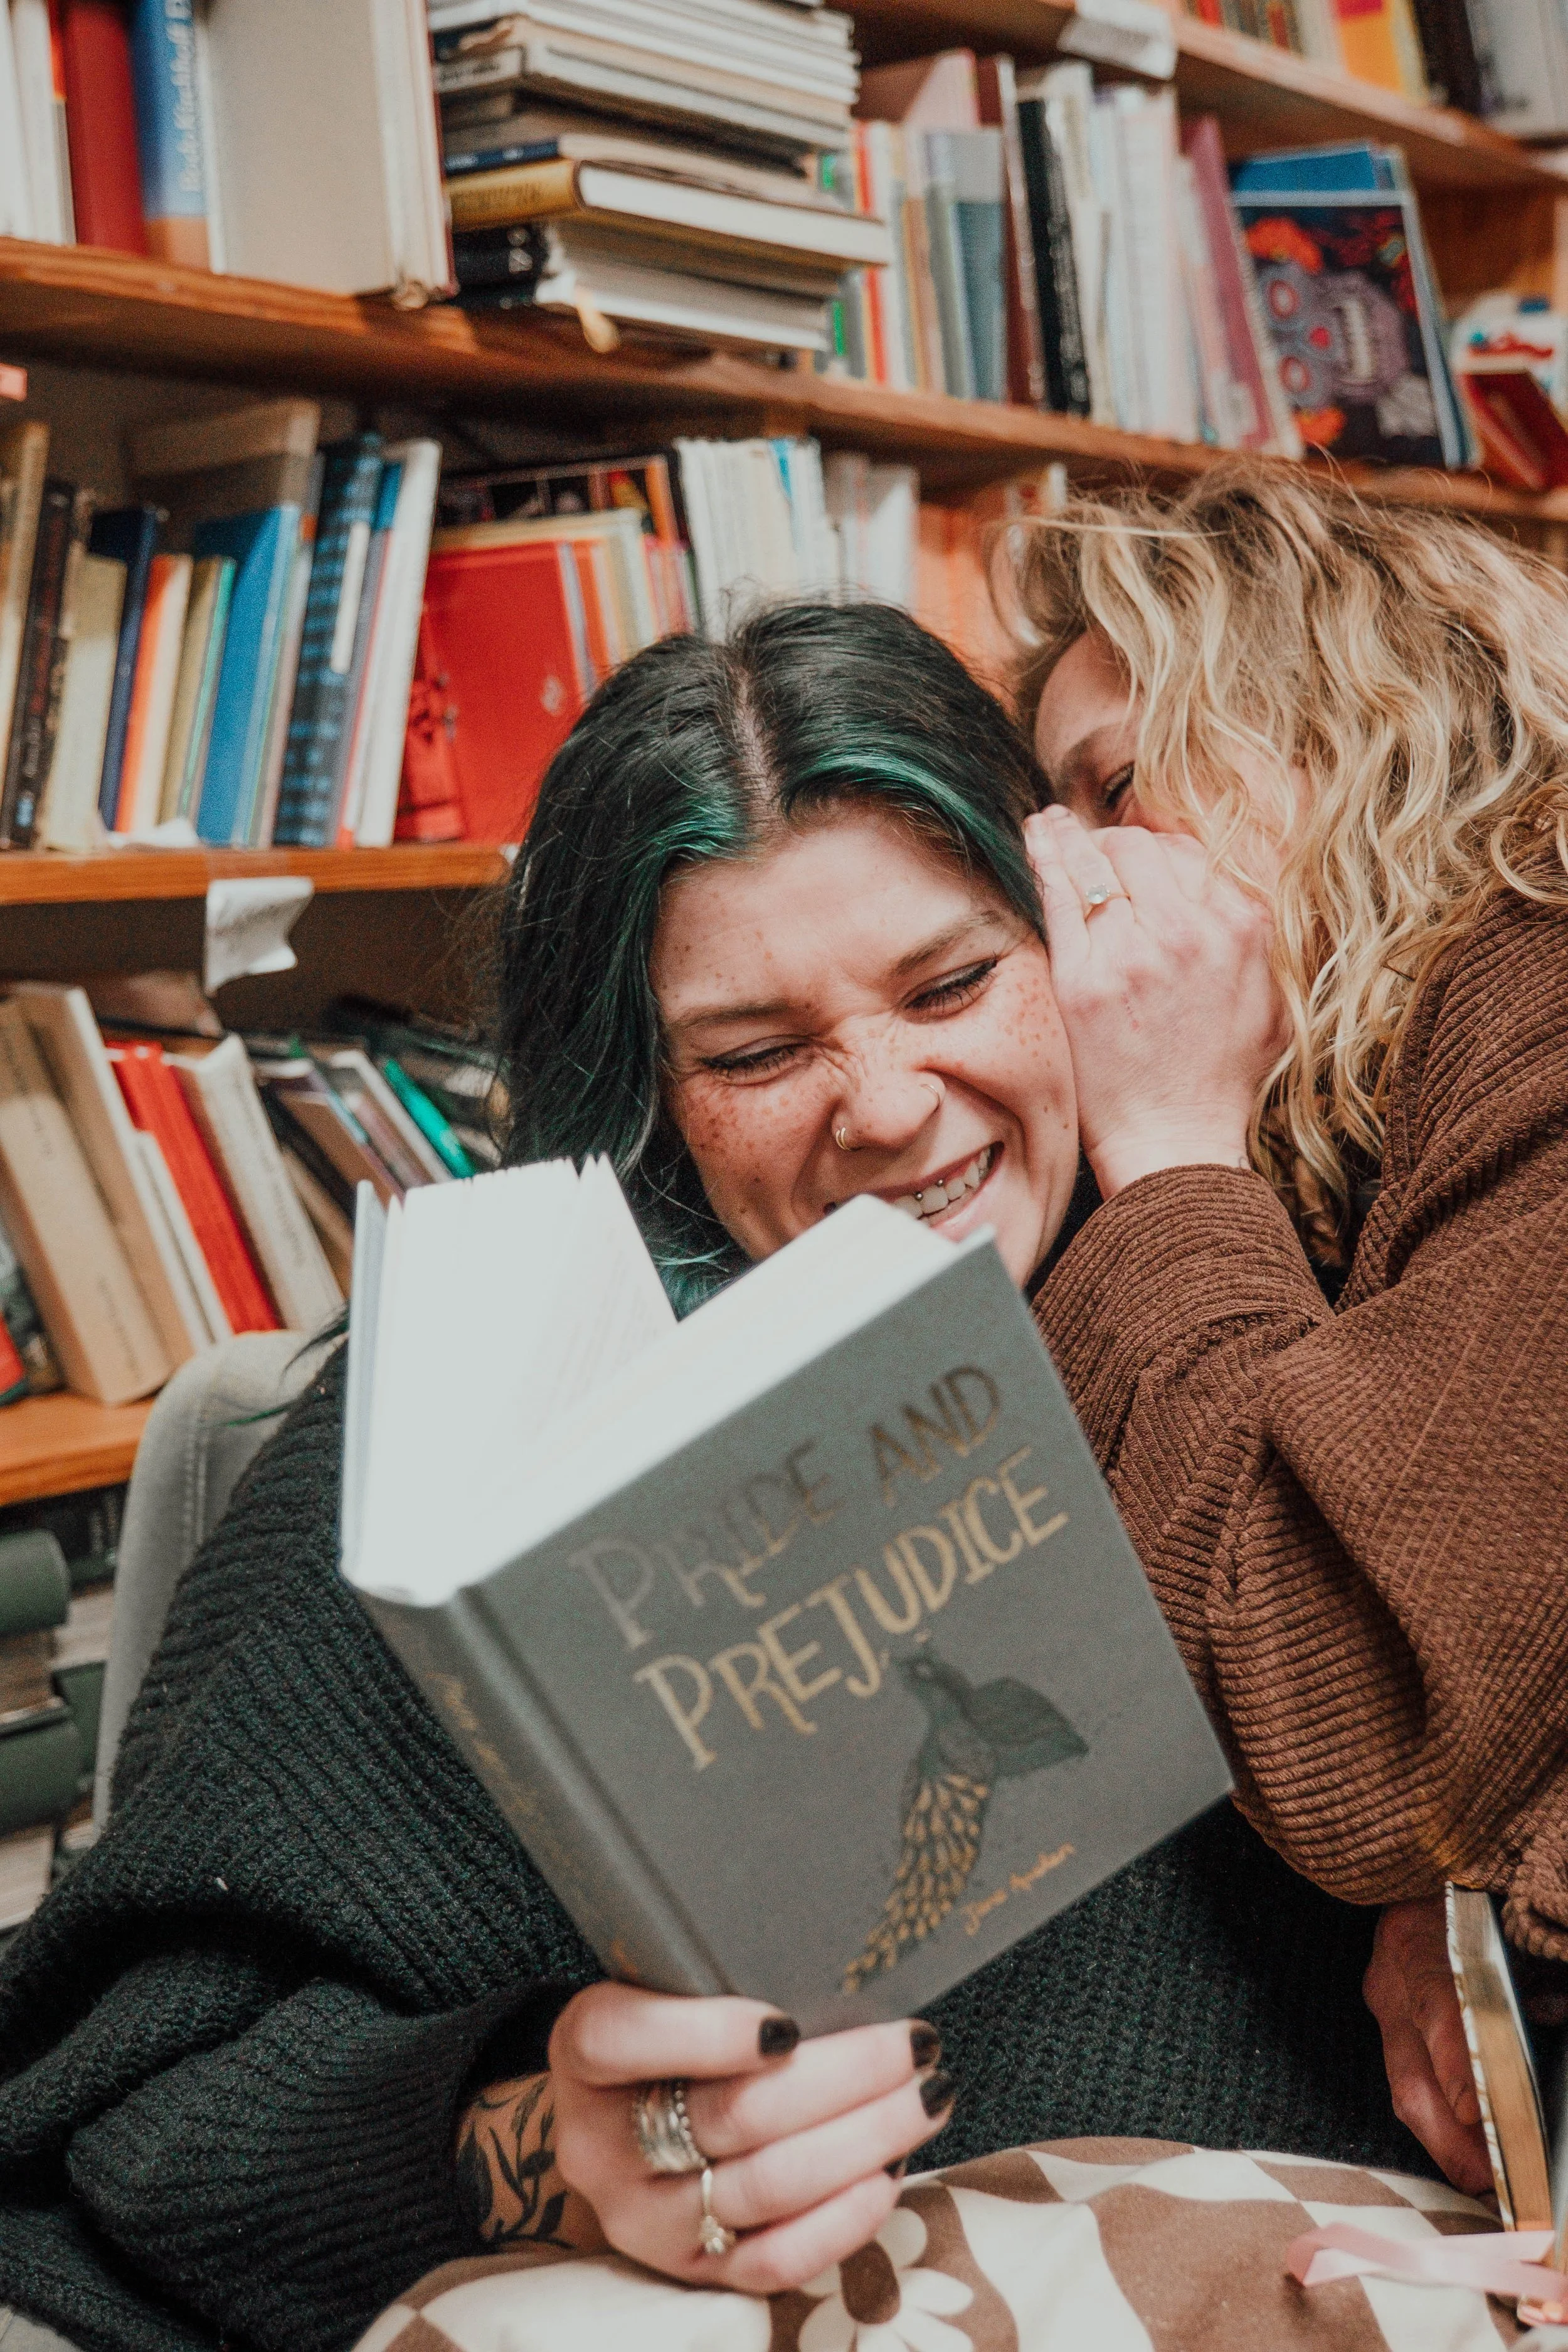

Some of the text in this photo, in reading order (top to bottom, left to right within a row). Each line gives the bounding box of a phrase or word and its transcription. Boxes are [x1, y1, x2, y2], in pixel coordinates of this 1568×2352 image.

[567, 1364, 1001, 1650] PRIDE AND
[633, 1446, 1069, 1772] PREJUDICE
